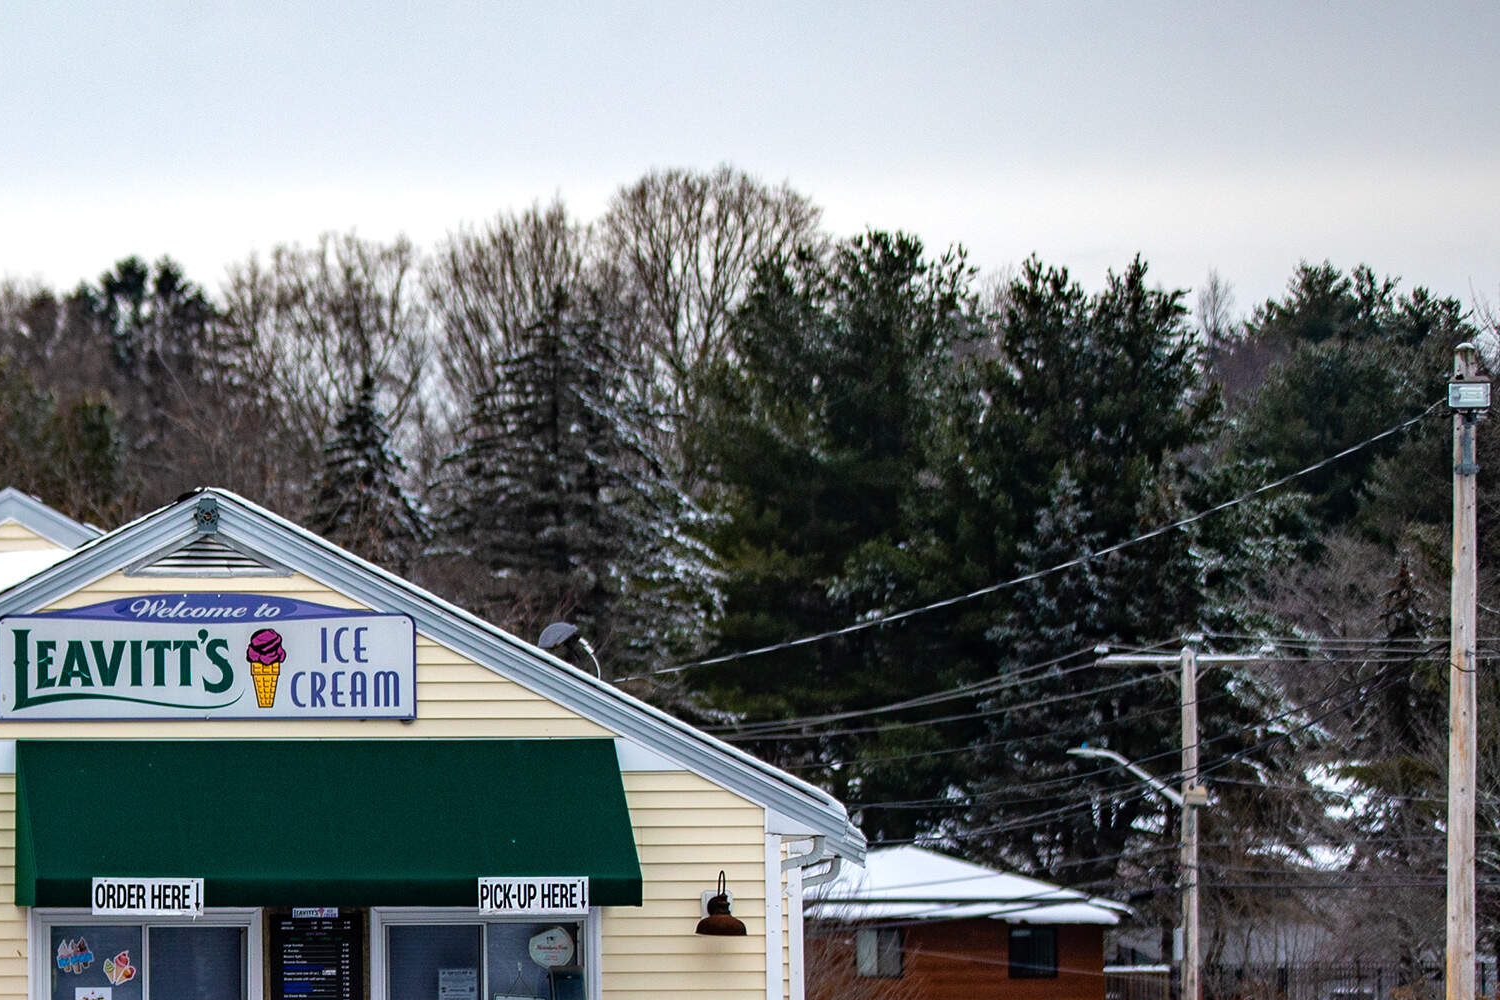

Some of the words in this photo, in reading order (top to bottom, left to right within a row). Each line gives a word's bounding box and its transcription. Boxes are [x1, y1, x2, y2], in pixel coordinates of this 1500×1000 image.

[130, 599, 248, 618] Welcome
[253, 603, 282, 618] to
[320, 626, 369, 664] ICE
[11, 628, 235, 711] LEAVITT'S
[290, 671, 400, 708] CREAM
[94, 883, 146, 909] ORDER
[150, 884, 191, 910] HERE
[480, 883, 537, 909] PICK-UP
[541, 883, 578, 909] HERE
